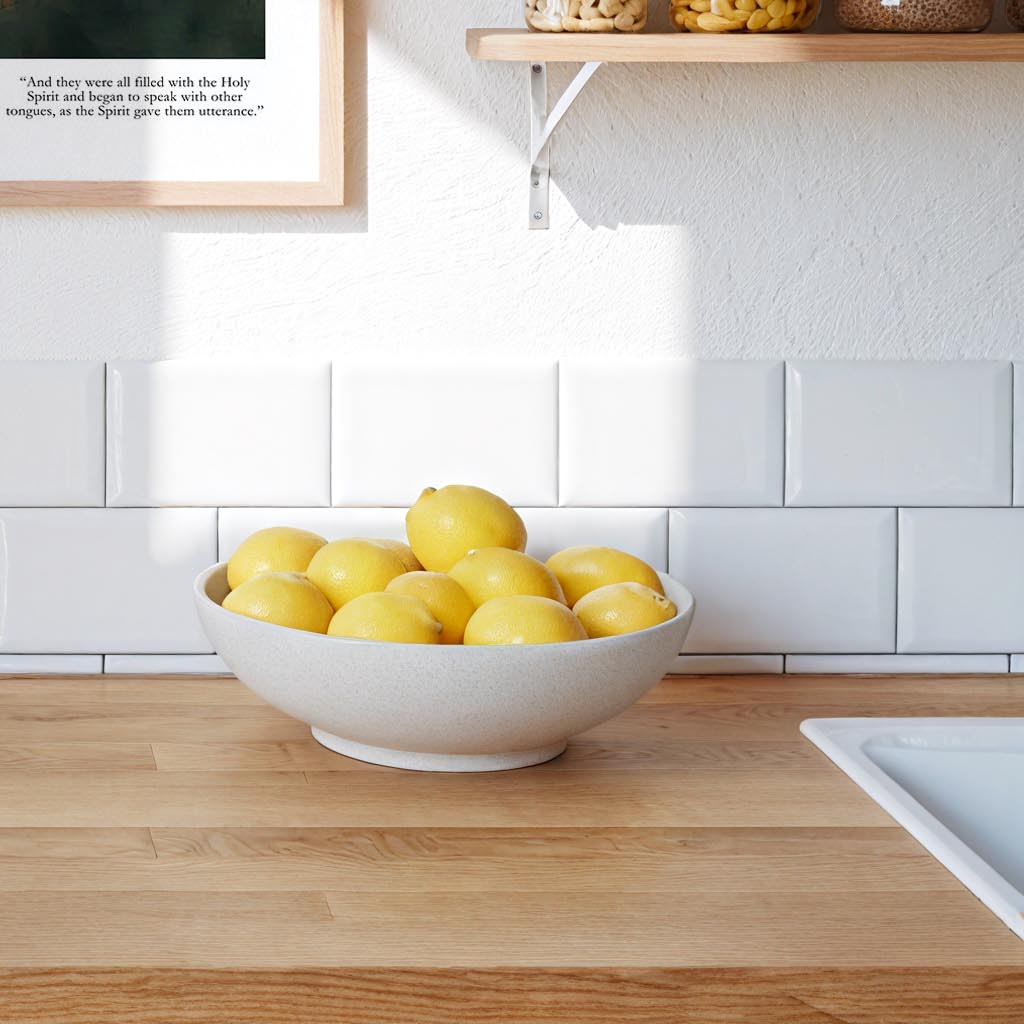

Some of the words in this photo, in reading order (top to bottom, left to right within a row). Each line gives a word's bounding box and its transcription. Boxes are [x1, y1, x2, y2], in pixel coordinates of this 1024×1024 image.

[19, 76, 52, 88] “And
[56, 76, 82, 91] they
[85, 79, 114, 88] were
[117, 76, 131, 88] all
[135, 76, 165, 88] filled
[168, 76, 195, 88] with
[198, 76, 218, 88] the
[221, 76, 251, 91] Holy
[26, 90, 60, 105] Spirit
[63, 91, 85, 102] and
[89, 90, 124, 105] began
[128, 93, 141, 102] to
[144, 90, 178, 105] speak
[181, 90, 207, 102] with
[210, 90, 244, 102] other
[5, 107, 56, 119] tongues,
[59, 108, 72, 116] as
[75, 105, 95, 116] the
[97, 105, 130, 119] Spirit
[133, 108, 161, 119] gave
[165, 105, 195, 116] them
[198, 105, 265, 117] utterance.”
